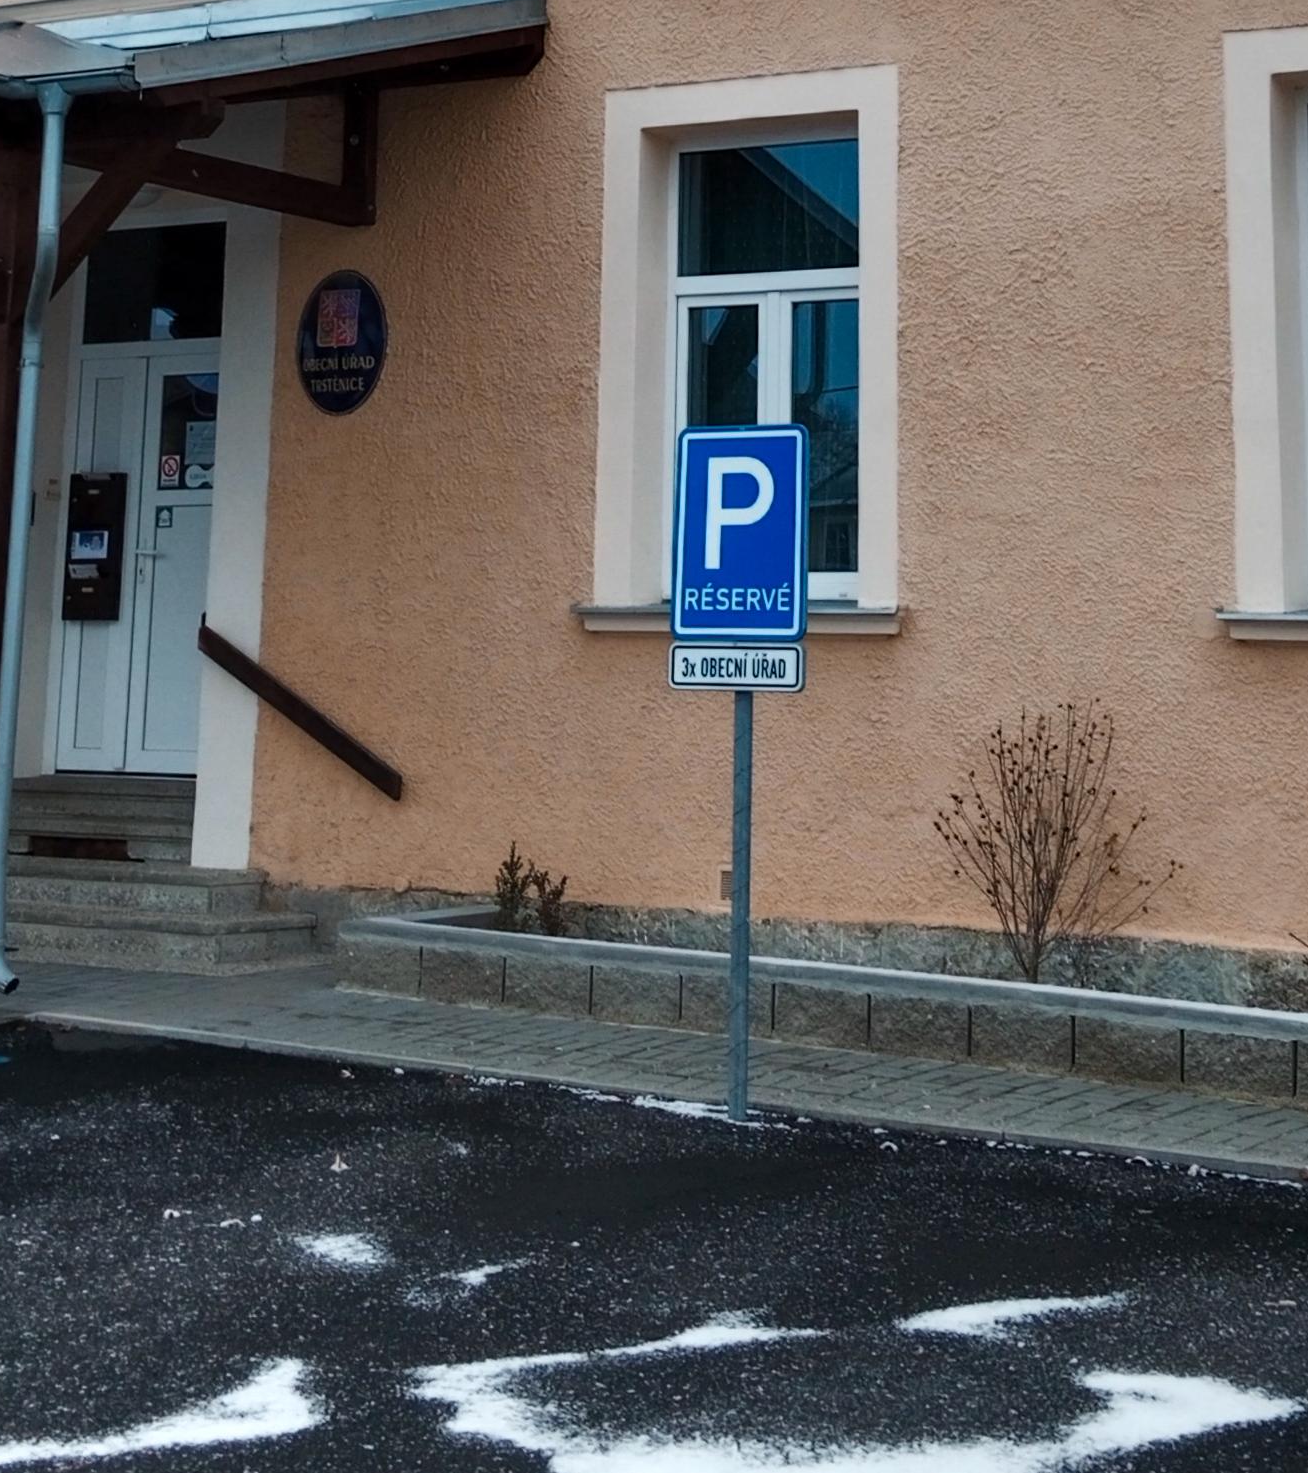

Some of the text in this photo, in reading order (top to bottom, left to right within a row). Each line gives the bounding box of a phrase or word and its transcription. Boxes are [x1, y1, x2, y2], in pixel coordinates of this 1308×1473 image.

[302, 353, 376, 372] OBECNÍ ÚŘAD
[704, 456, 775, 570] P
[684, 582, 791, 611] RÉSERVÉ
[681, 652, 787, 679] 3x OBECNÍ ÚŘAD
